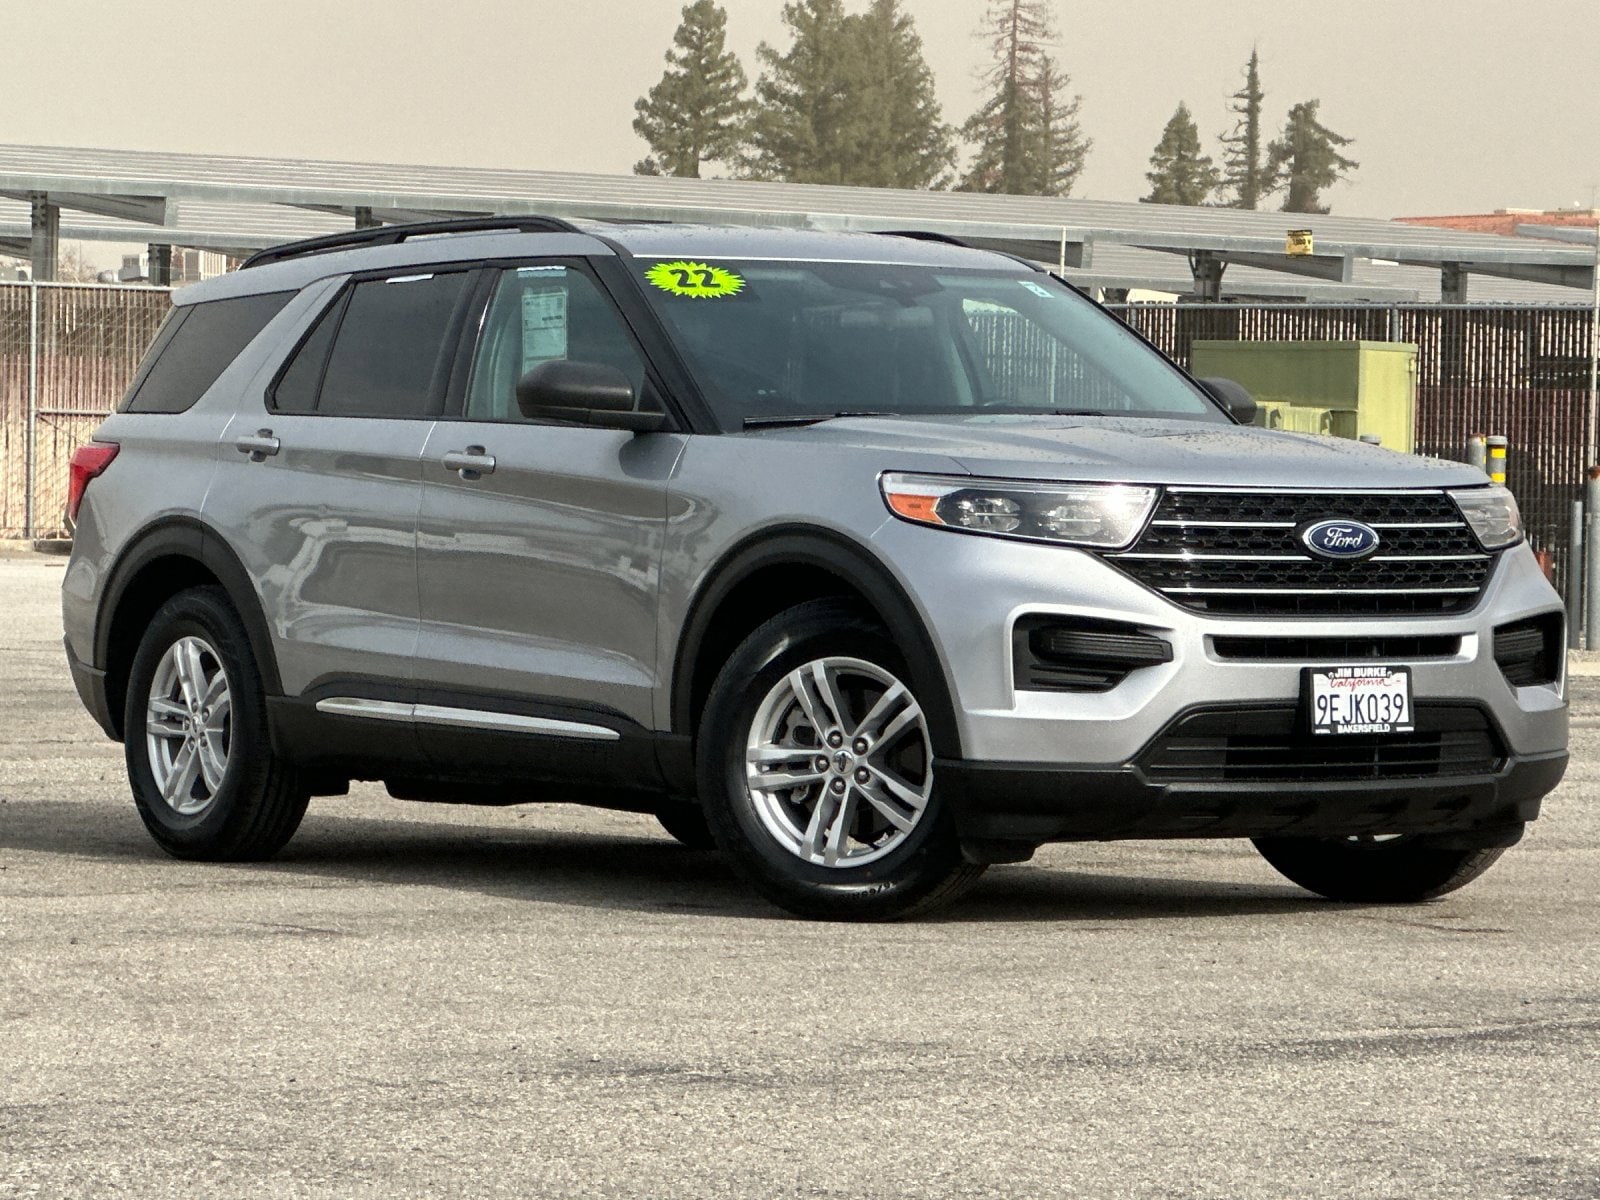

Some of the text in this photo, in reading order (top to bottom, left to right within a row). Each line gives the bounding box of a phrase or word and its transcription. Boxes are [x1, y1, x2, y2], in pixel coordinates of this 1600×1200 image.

[669, 268, 721, 288] 22
[1324, 527, 1363, 548] Ford
[1335, 667, 1387, 678] JIM BURKE
[1329, 677, 1392, 692] California
[1317, 693, 1404, 725] 9EJK039
[1337, 724, 1391, 733] BAKERSFIELD
